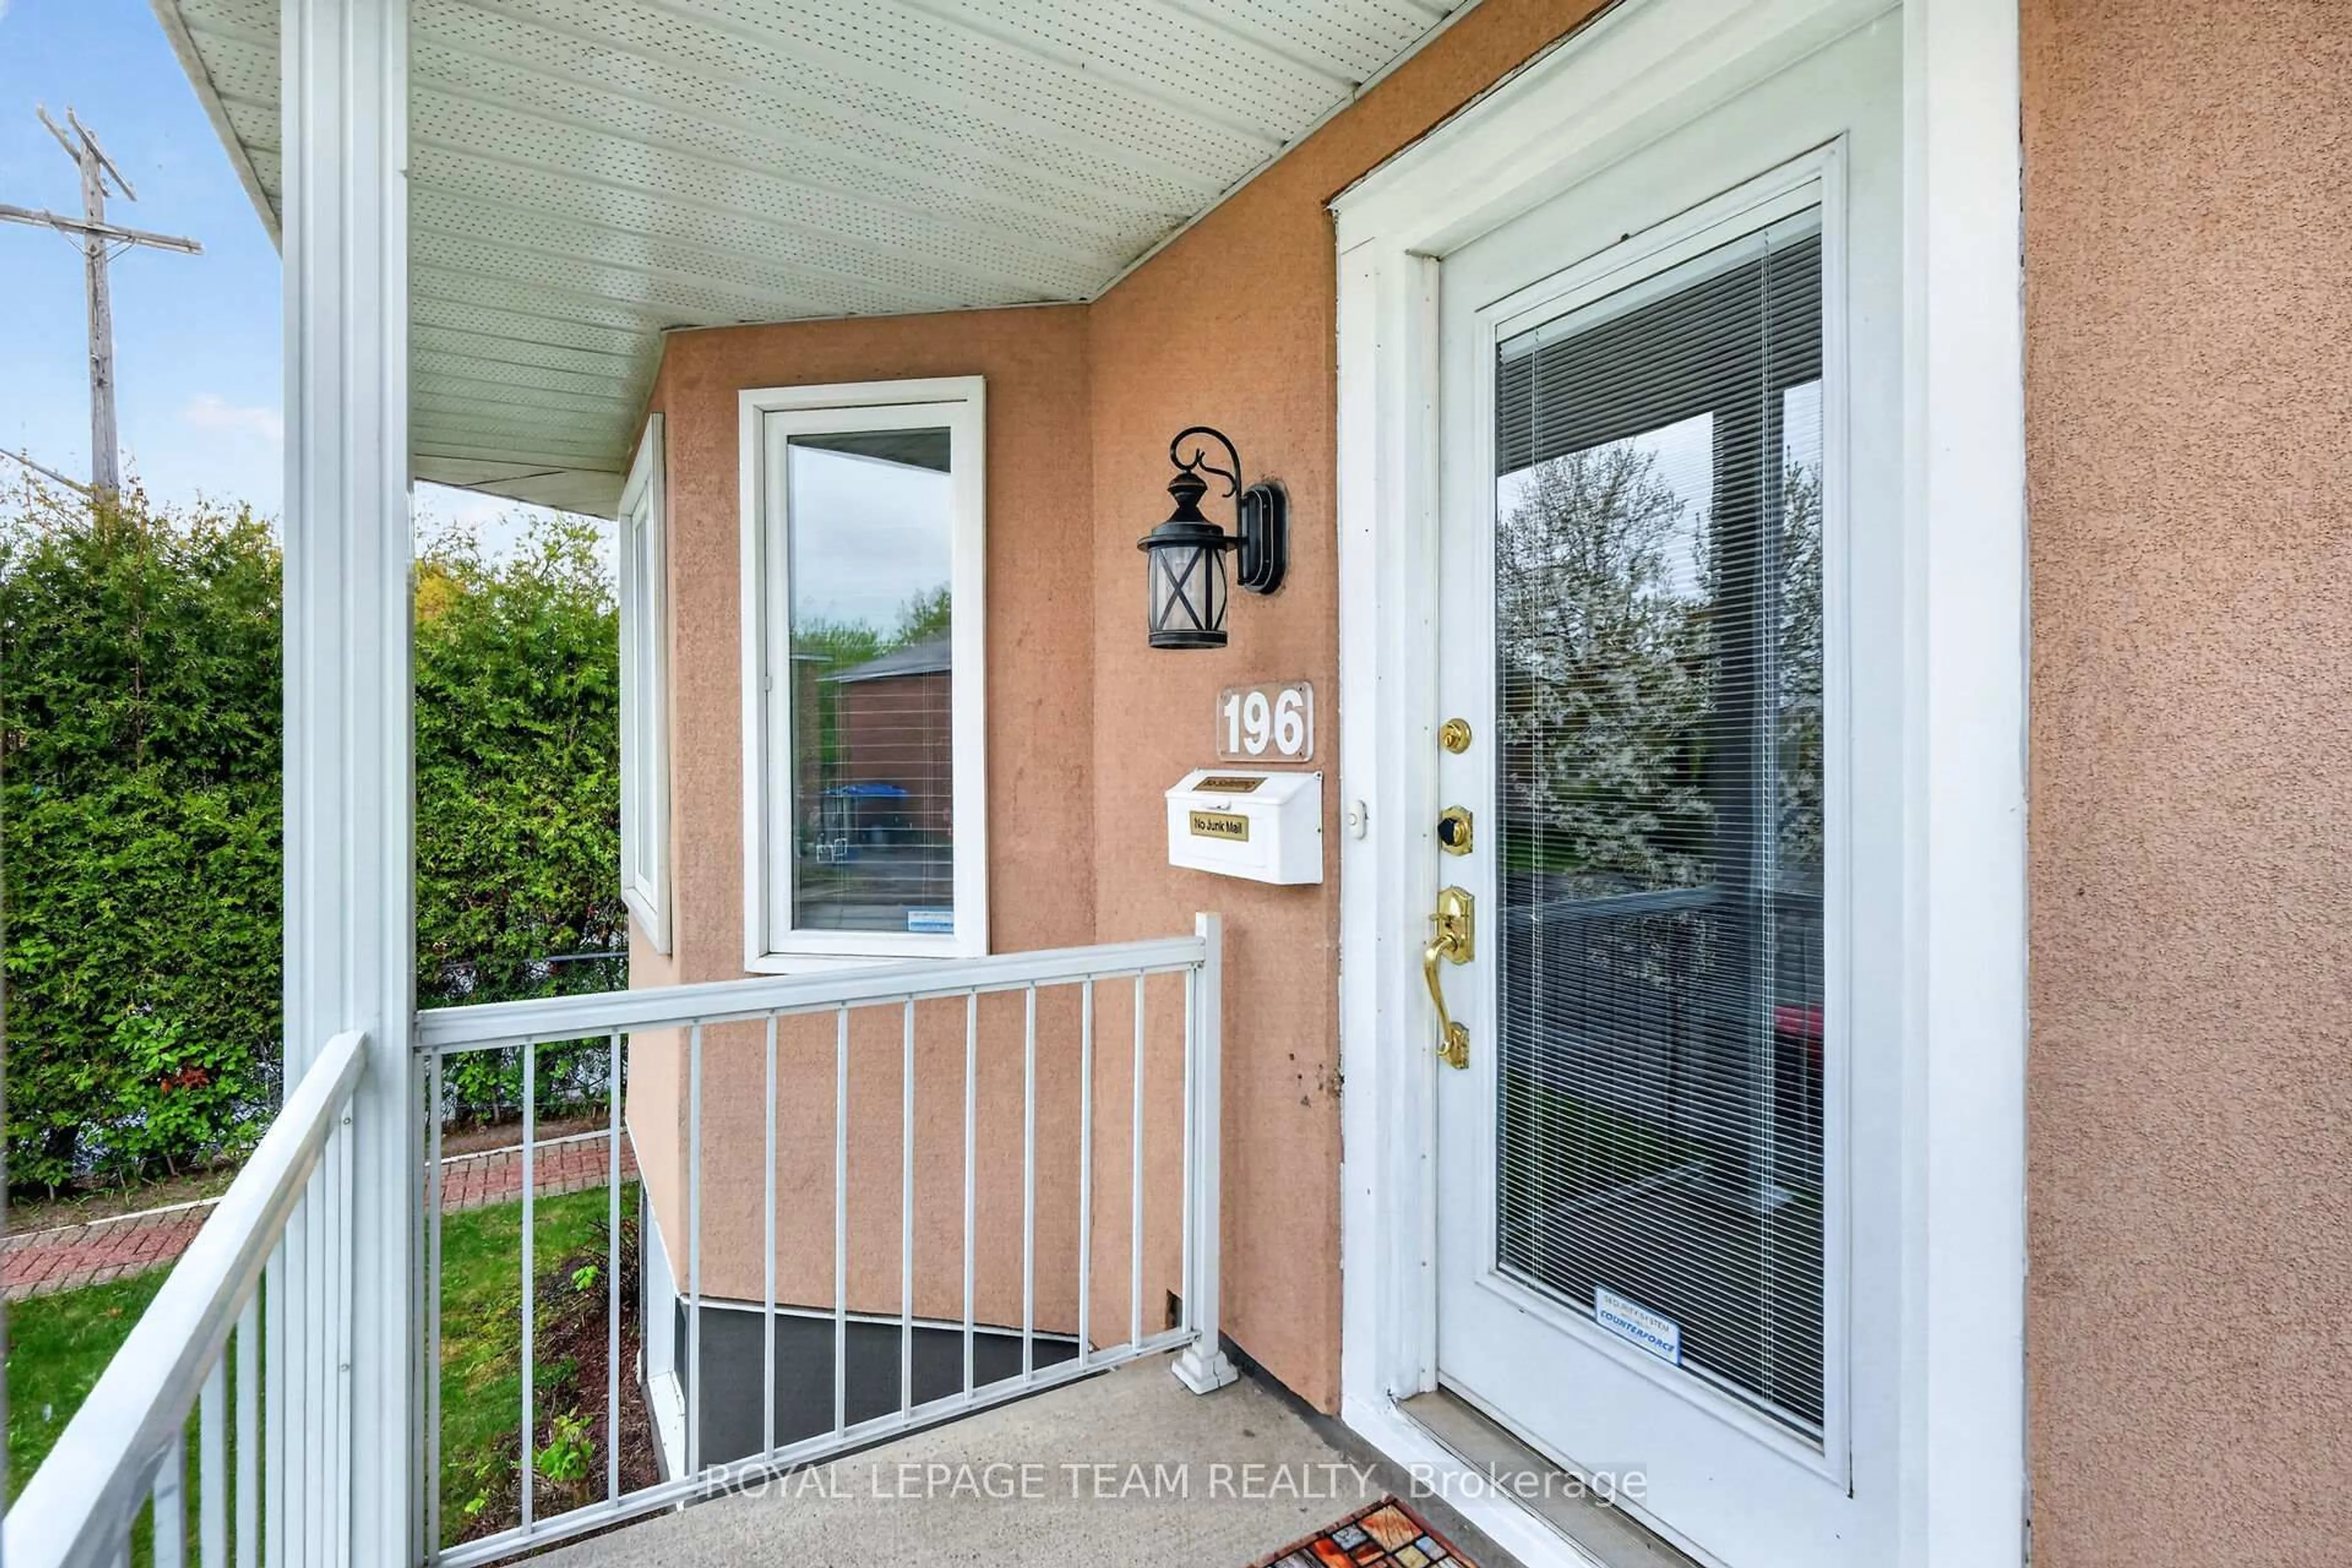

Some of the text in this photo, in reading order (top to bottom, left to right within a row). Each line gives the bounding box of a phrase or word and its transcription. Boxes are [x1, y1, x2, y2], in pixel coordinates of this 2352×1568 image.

[1224, 690, 1304, 755] 196
[1194, 817, 1242, 834] No Junk Mail
